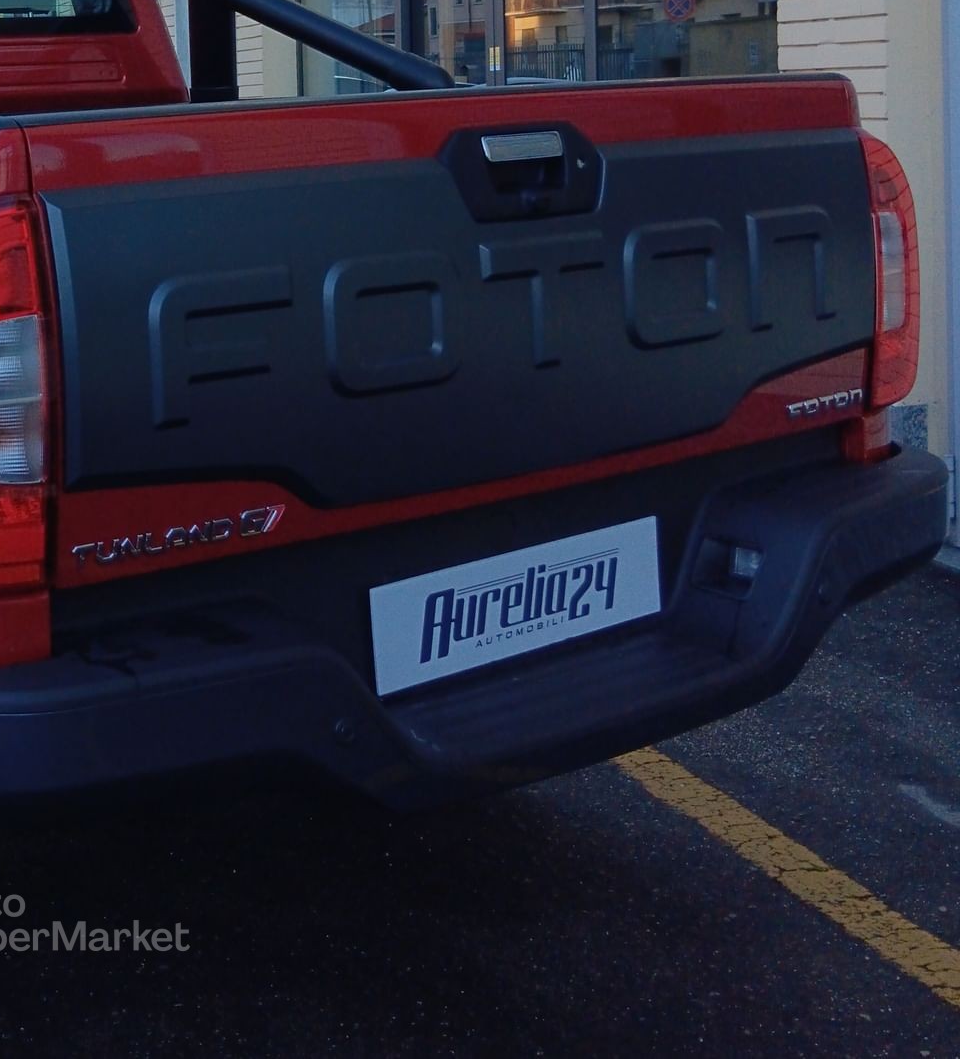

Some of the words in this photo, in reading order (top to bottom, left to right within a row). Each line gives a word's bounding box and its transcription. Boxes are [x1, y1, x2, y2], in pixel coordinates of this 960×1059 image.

[148, 204, 838, 430] FOTON
[786, 388, 863, 417] FOTON
[71, 517, 234, 566] TUNLAND
[420, 556, 618, 664] Aurelia24
[474, 616, 566, 648] AUTOMOBILI
